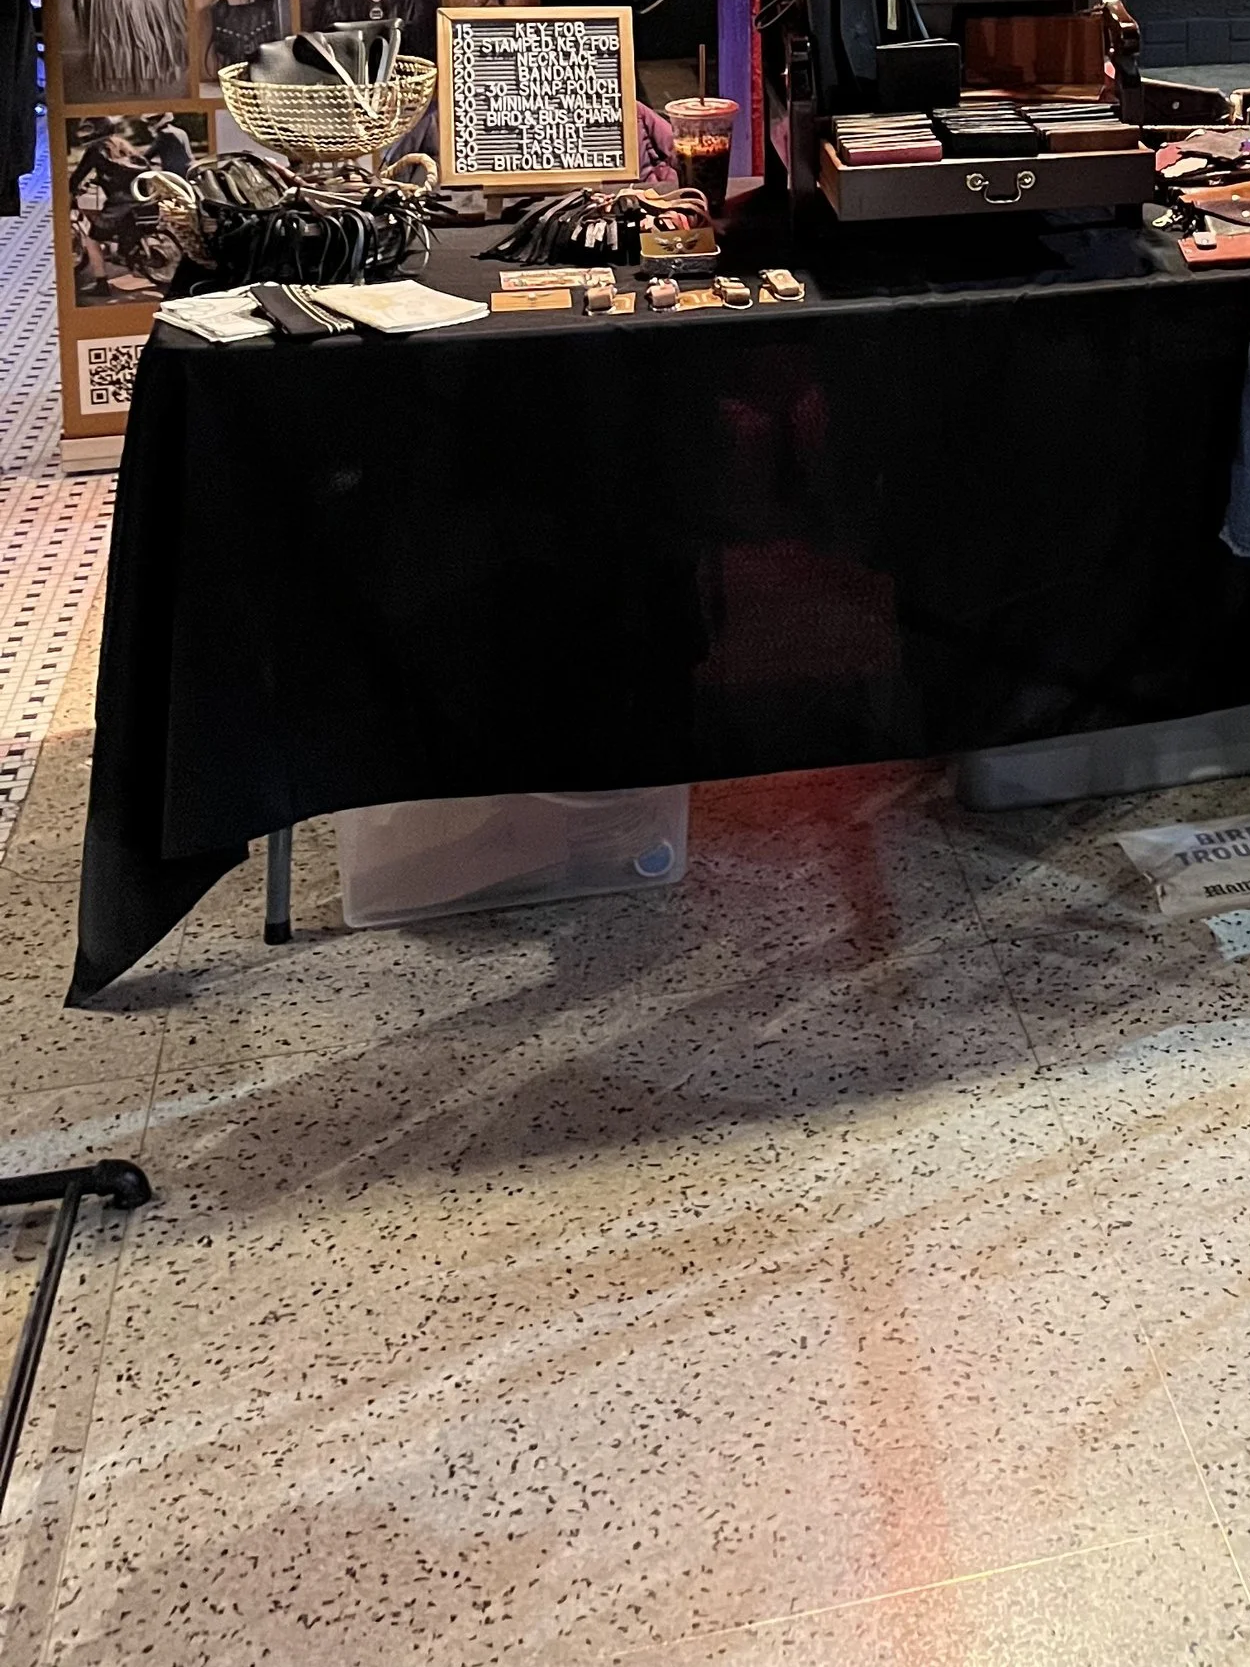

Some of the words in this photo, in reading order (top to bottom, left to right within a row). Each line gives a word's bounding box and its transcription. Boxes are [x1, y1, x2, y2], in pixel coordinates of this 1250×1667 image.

[456, 24, 473, 38] 15
[515, 23, 546, 38] KEY
[554, 22, 586, 36] FOB
[453, 38, 475, 54] 20
[481, 37, 552, 53] STAMPED
[557, 36, 587, 53] KEY
[591, 35, 619, 51] FOB
[454, 53, 475, 68] 20
[454, 68, 475, 83] 20
[518, 65, 597, 81] BANDANA
[519, 81, 561, 96] SNAP
[566, 79, 618, 94] POUCH
[455, 95, 477, 111] 30
[490, 95, 555, 111] MINIMAL
[561, 94, 621, 109] WALLET
[455, 111, 477, 127] 30
[487, 111, 522, 126] BIRD
[524, 111, 537, 125] &
[539, 109, 568, 125] BUS
[573, 108, 622, 124] CHARM
[456, 127, 477, 142] 30
[456, 142, 478, 157] 50
[519, 139, 588, 155] TASSEL
[457, 157, 478, 173] 65
[494, 154, 555, 171] BIFOLD
[561, 151, 622, 167] WALLET
